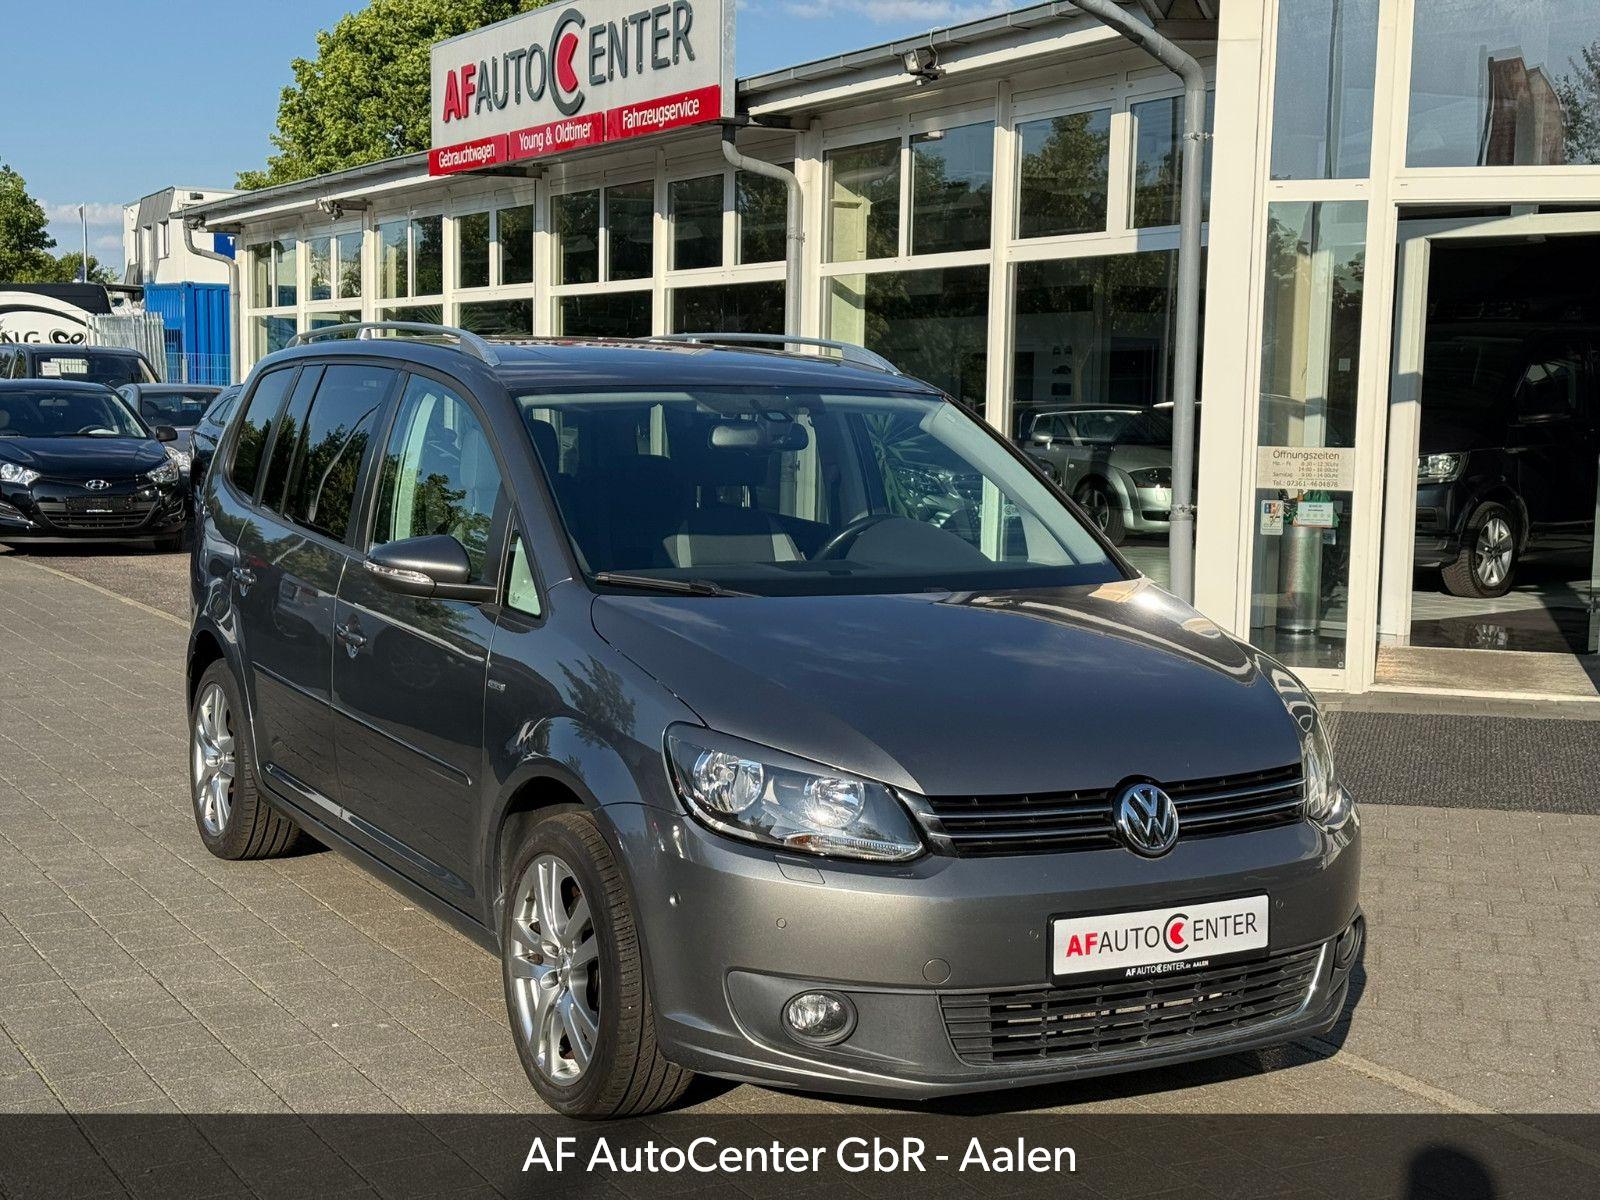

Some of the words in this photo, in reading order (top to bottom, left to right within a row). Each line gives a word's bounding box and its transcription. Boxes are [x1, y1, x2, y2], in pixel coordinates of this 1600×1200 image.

[622, 97, 699, 130] Fahrzeugservice
[519, 130, 544, 150] Young
[546, 127, 552, 146] &
[555, 122, 592, 142] Oldtimer
[438, 143, 495, 168] Gebrauchtwagen
[1273, 450, 1340, 461] Öffnungszeiten
[1192, 960, 1209, 968] AALEN
